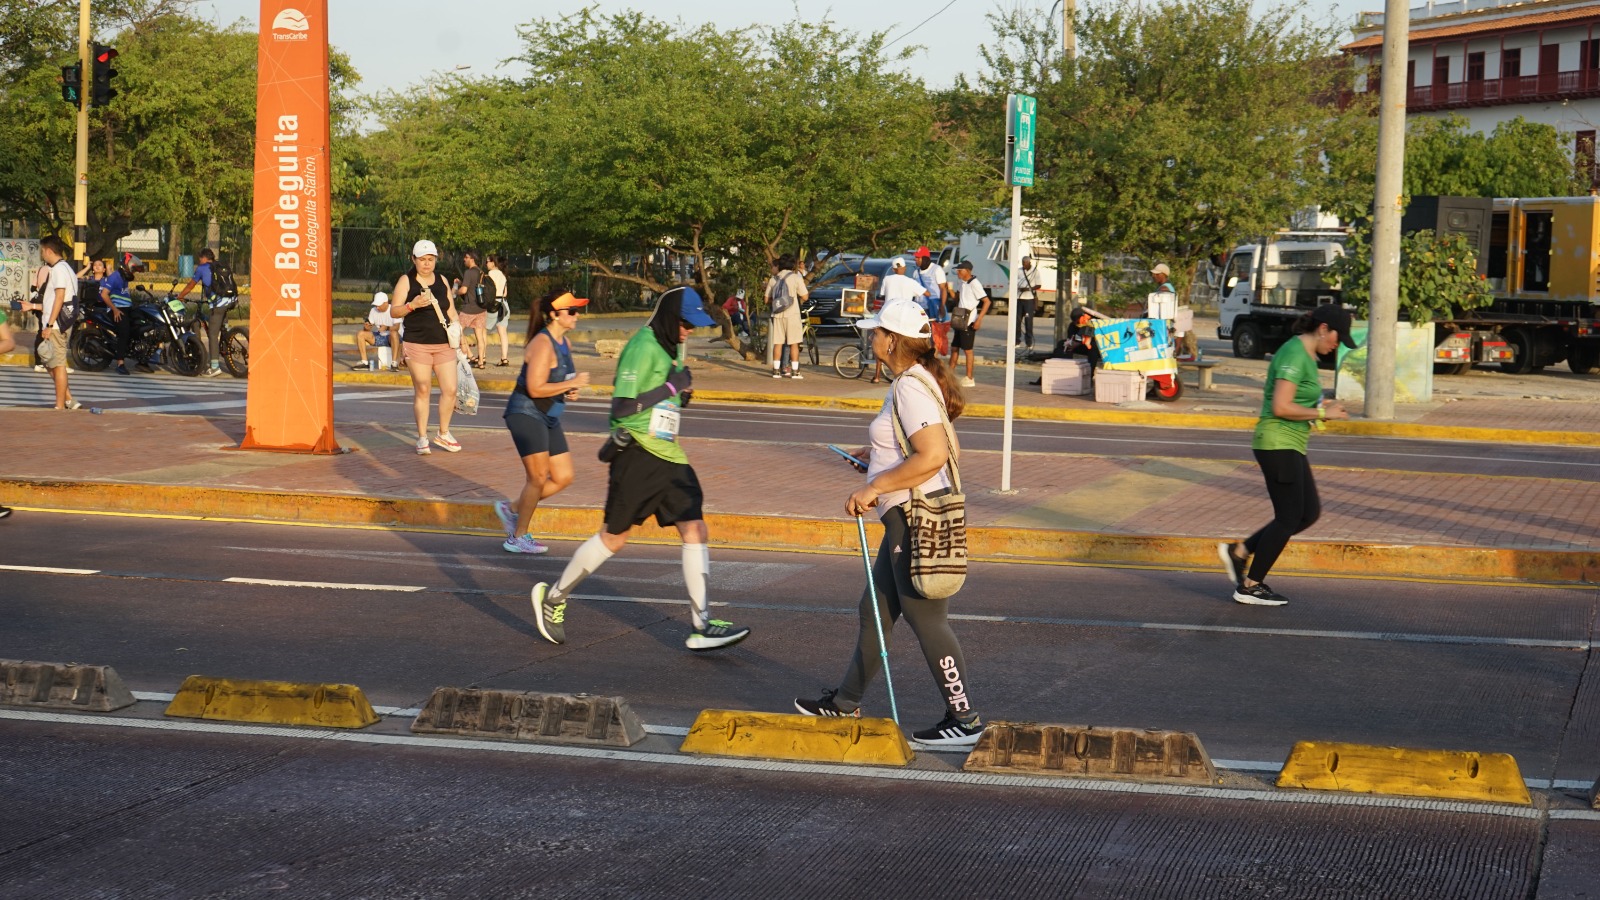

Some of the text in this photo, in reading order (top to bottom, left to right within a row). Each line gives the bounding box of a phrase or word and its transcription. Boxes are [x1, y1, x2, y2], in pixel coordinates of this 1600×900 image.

[273, 32, 308, 40] TransCaribe
[273, 115, 304, 317] La Bodeguita
[303, 156, 320, 275] La Bodeguita Station
